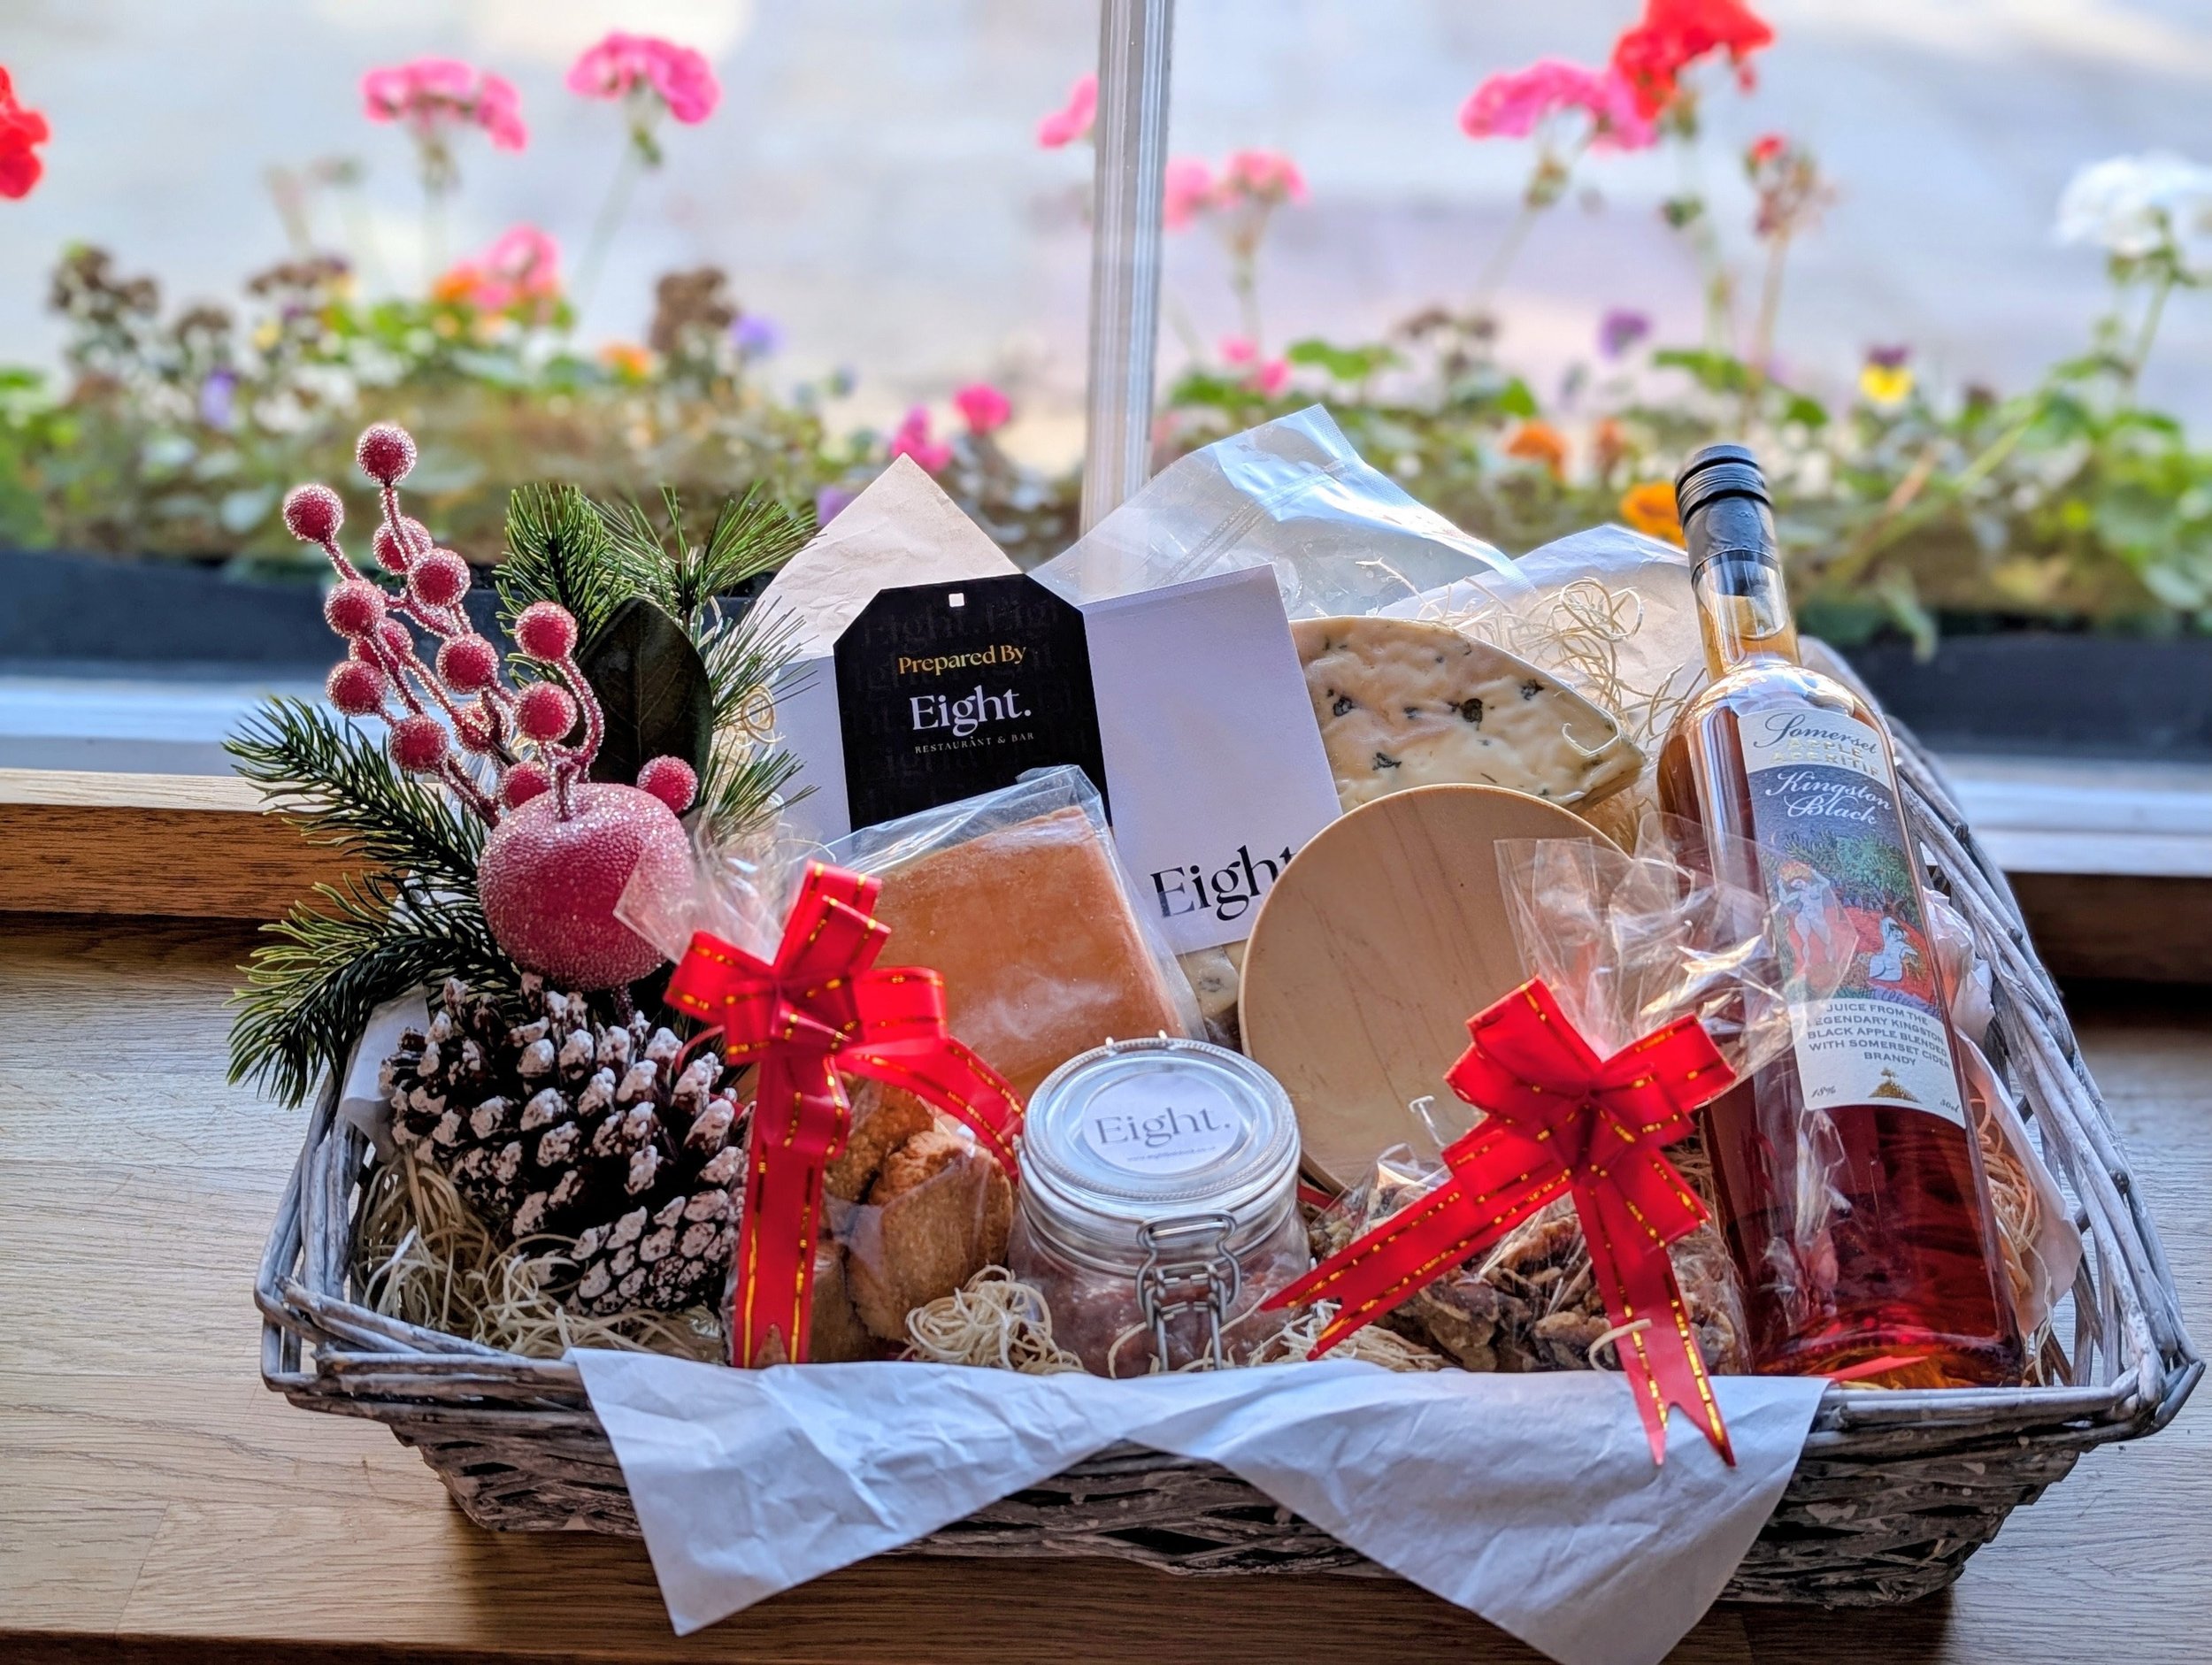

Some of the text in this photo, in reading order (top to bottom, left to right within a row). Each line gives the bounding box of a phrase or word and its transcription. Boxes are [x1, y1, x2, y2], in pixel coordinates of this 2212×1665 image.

[898, 644, 996, 676] Prepared
[1000, 644, 1027, 664] By
[909, 684, 1032, 737] Eight.
[914, 732, 1034, 754] RESTAURANT & BAR
[1753, 712, 1877, 754] Somerset
[1788, 737, 1863, 759] APPLE
[1770, 750, 1879, 777] APERITIF
[1764, 771, 1892, 809] Kingston
[1784, 793, 1878, 825] Black
[1826, 1002, 1929, 1026] JUICE FROM THE
[1808, 1027, 1947, 1057] BLACK APPLE BLENDED
[1891, 1018, 1944, 1046] KINGSTON
[1809, 1040, 1951, 1070] WITH SOMERSET CIDER
[1863, 1051, 1916, 1066] BRANDY
[1811, 1086, 1837, 1098] 18%
[1094, 1107, 1231, 1147] Eight.
